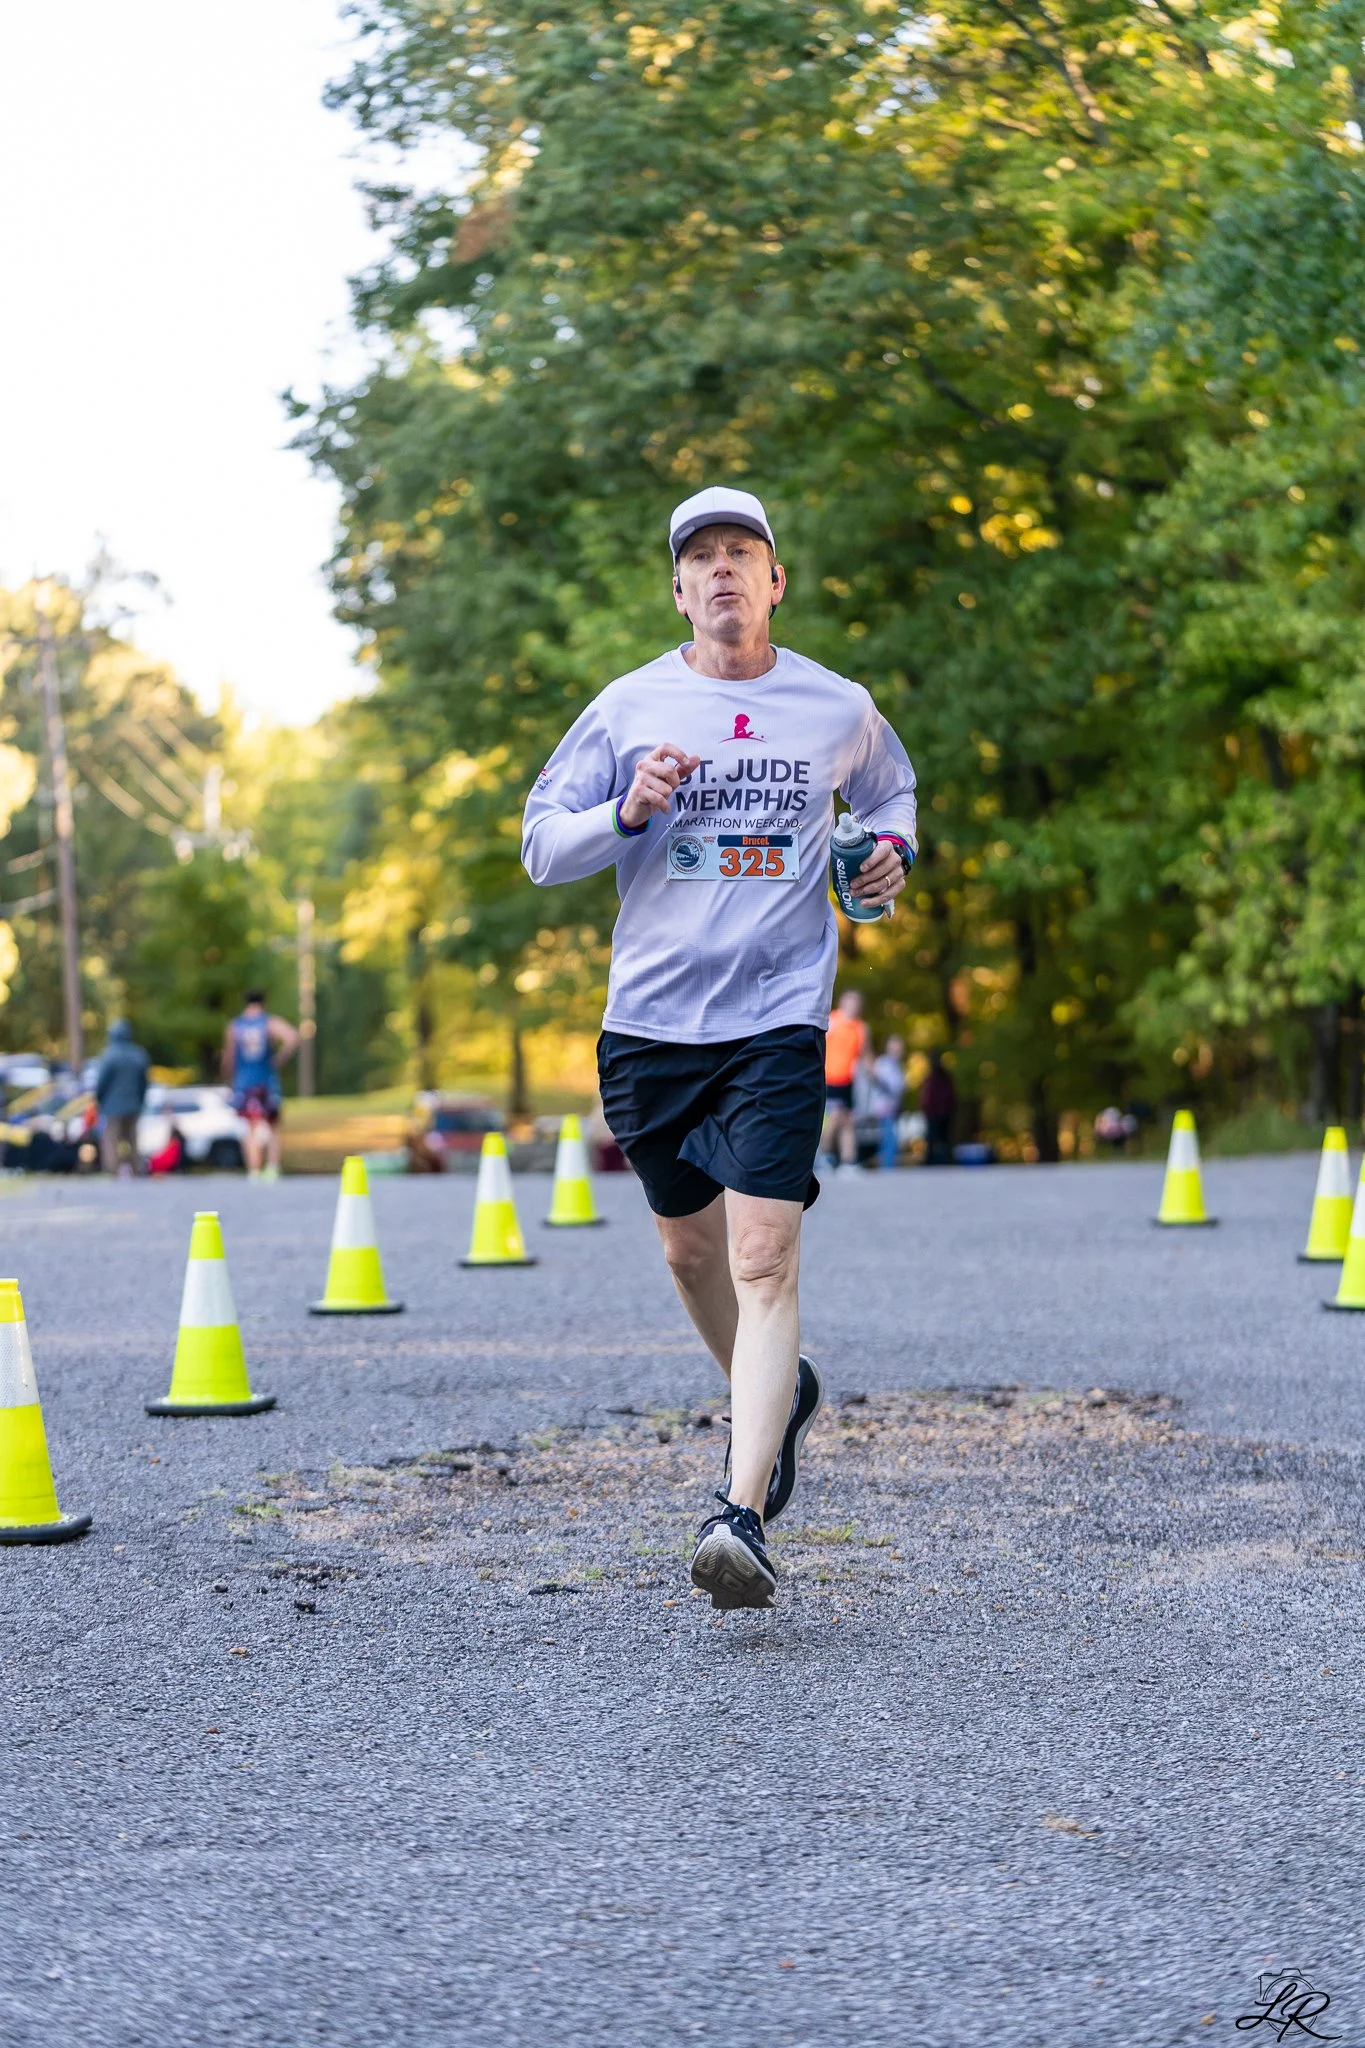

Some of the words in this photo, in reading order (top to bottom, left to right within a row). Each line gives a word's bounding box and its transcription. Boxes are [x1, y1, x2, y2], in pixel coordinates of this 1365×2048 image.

[725, 759, 810, 785] JUDE
[675, 788, 809, 812] MEMPHIS
[671, 817, 742, 829] MARATHON
[719, 847, 785, 877] 325
